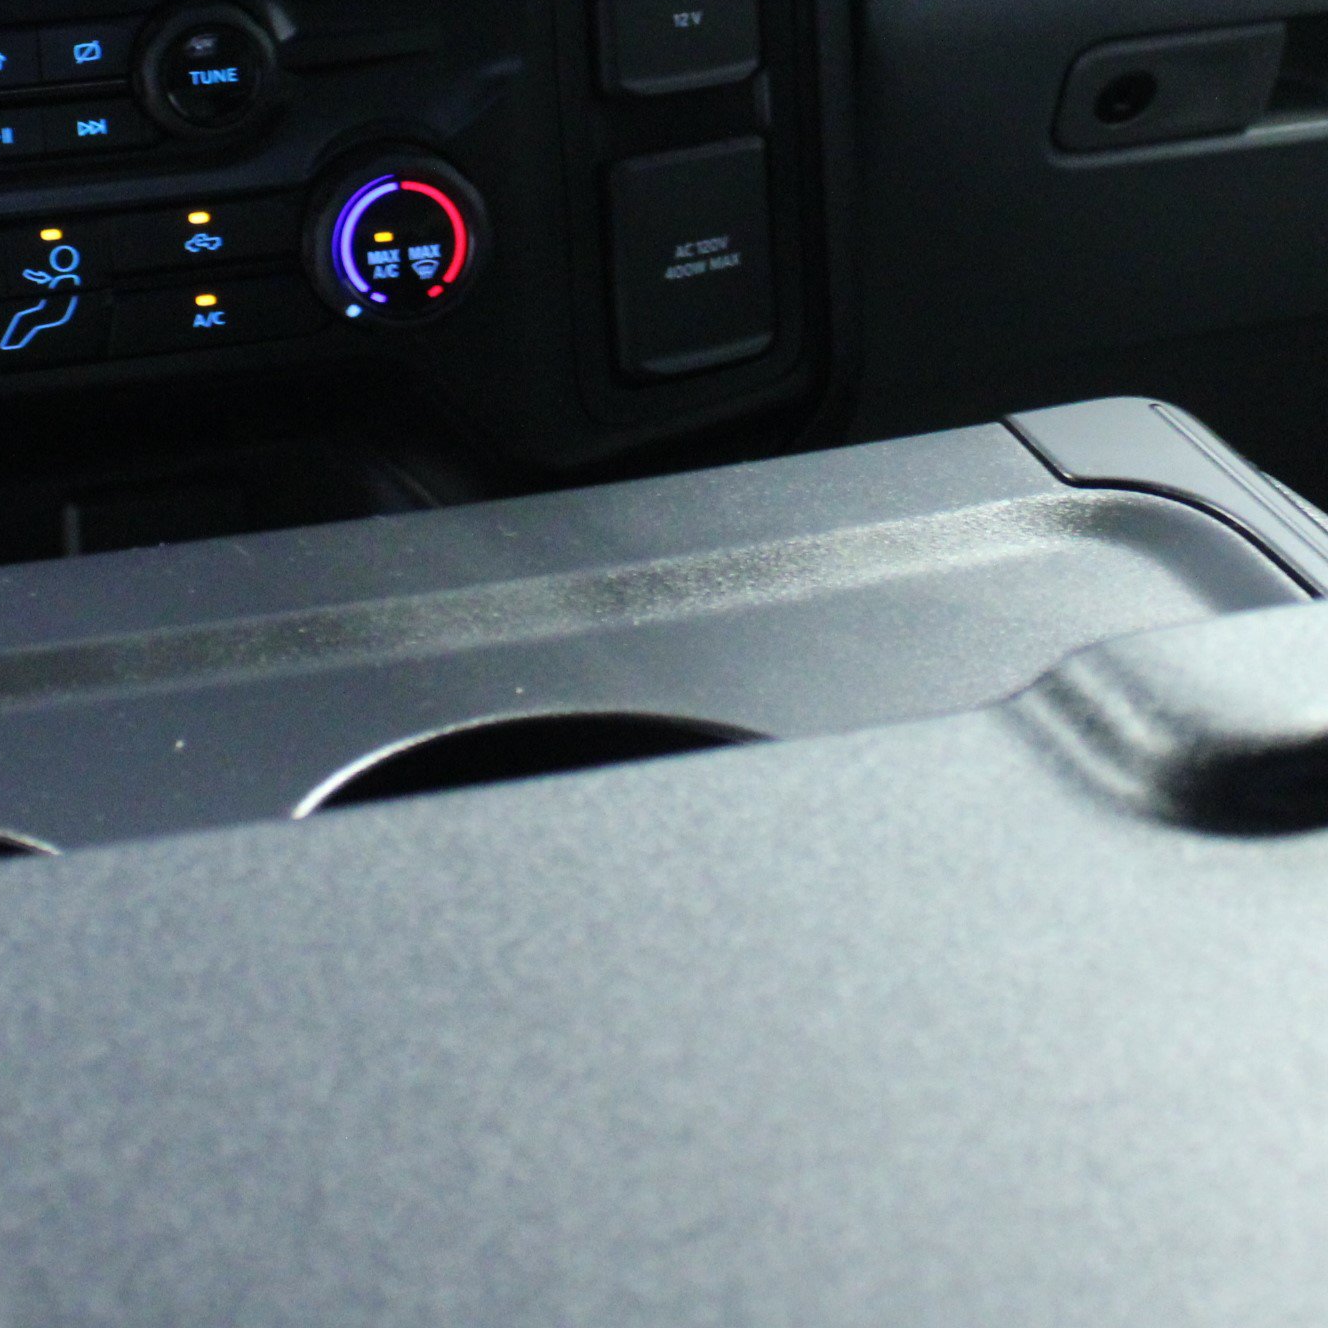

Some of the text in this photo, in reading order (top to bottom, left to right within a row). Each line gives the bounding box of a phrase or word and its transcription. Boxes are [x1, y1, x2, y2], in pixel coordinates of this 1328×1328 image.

[188, 67, 240, 86] TUNE
[367, 249, 400, 265] MAX
[408, 244, 441, 261] MAX
[373, 264, 400, 279] A/C
[192, 311, 226, 328] A/C
